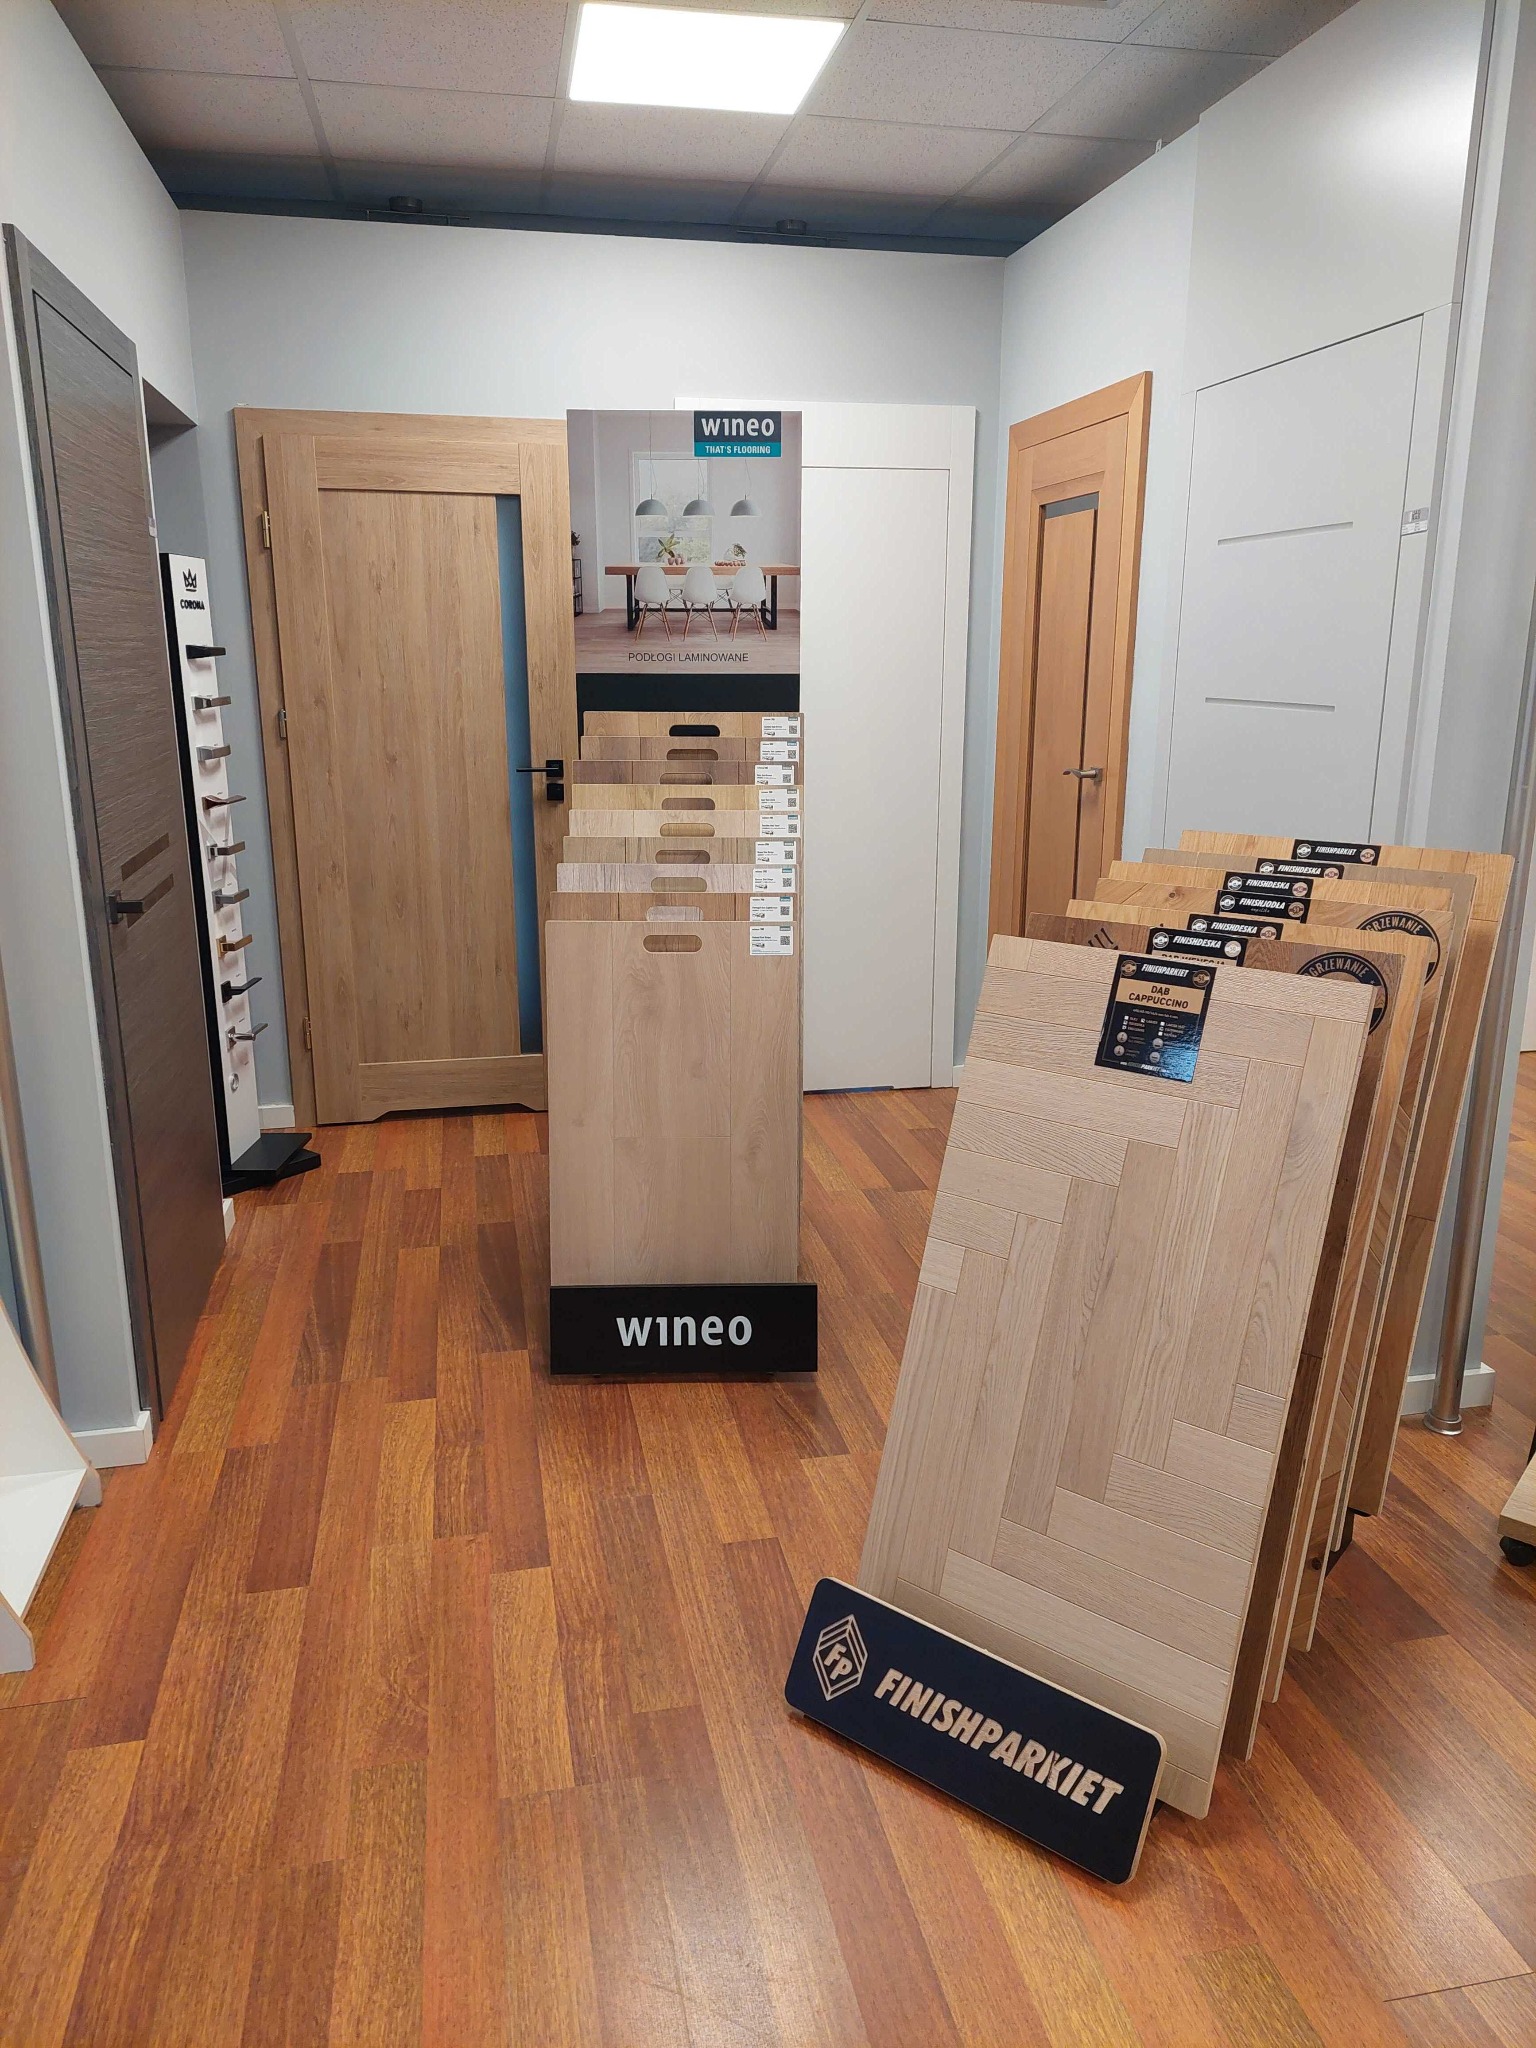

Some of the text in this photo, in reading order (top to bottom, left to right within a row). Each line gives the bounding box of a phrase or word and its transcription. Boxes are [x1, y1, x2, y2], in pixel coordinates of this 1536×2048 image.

[705, 445, 771, 454] THAT'S FLOORING
[180, 599, 206, 610] CORONA
[628, 652, 749, 662] PODŁOGI LAMINOWANE
[1315, 846, 1357, 856] FINISHPARKIET
[1277, 865, 1322, 875] FINISHDESKA
[1245, 879, 1291, 890] FINISHDESKA
[1210, 922, 1258, 934] FINISHDESKA
[1366, 916, 1424, 935] GRZEWANIE
[1172, 935, 1222, 949] FINISHDESKA
[1141, 963, 1190, 978] FINISHPARKIET
[1304, 957, 1370, 978] GRZEWANIE
[1151, 985, 1171, 996] DĄB
[1128, 992, 1189, 1009] CAPPUCCINO
[874, 1667, 1125, 1815] FINISHPARKIET
